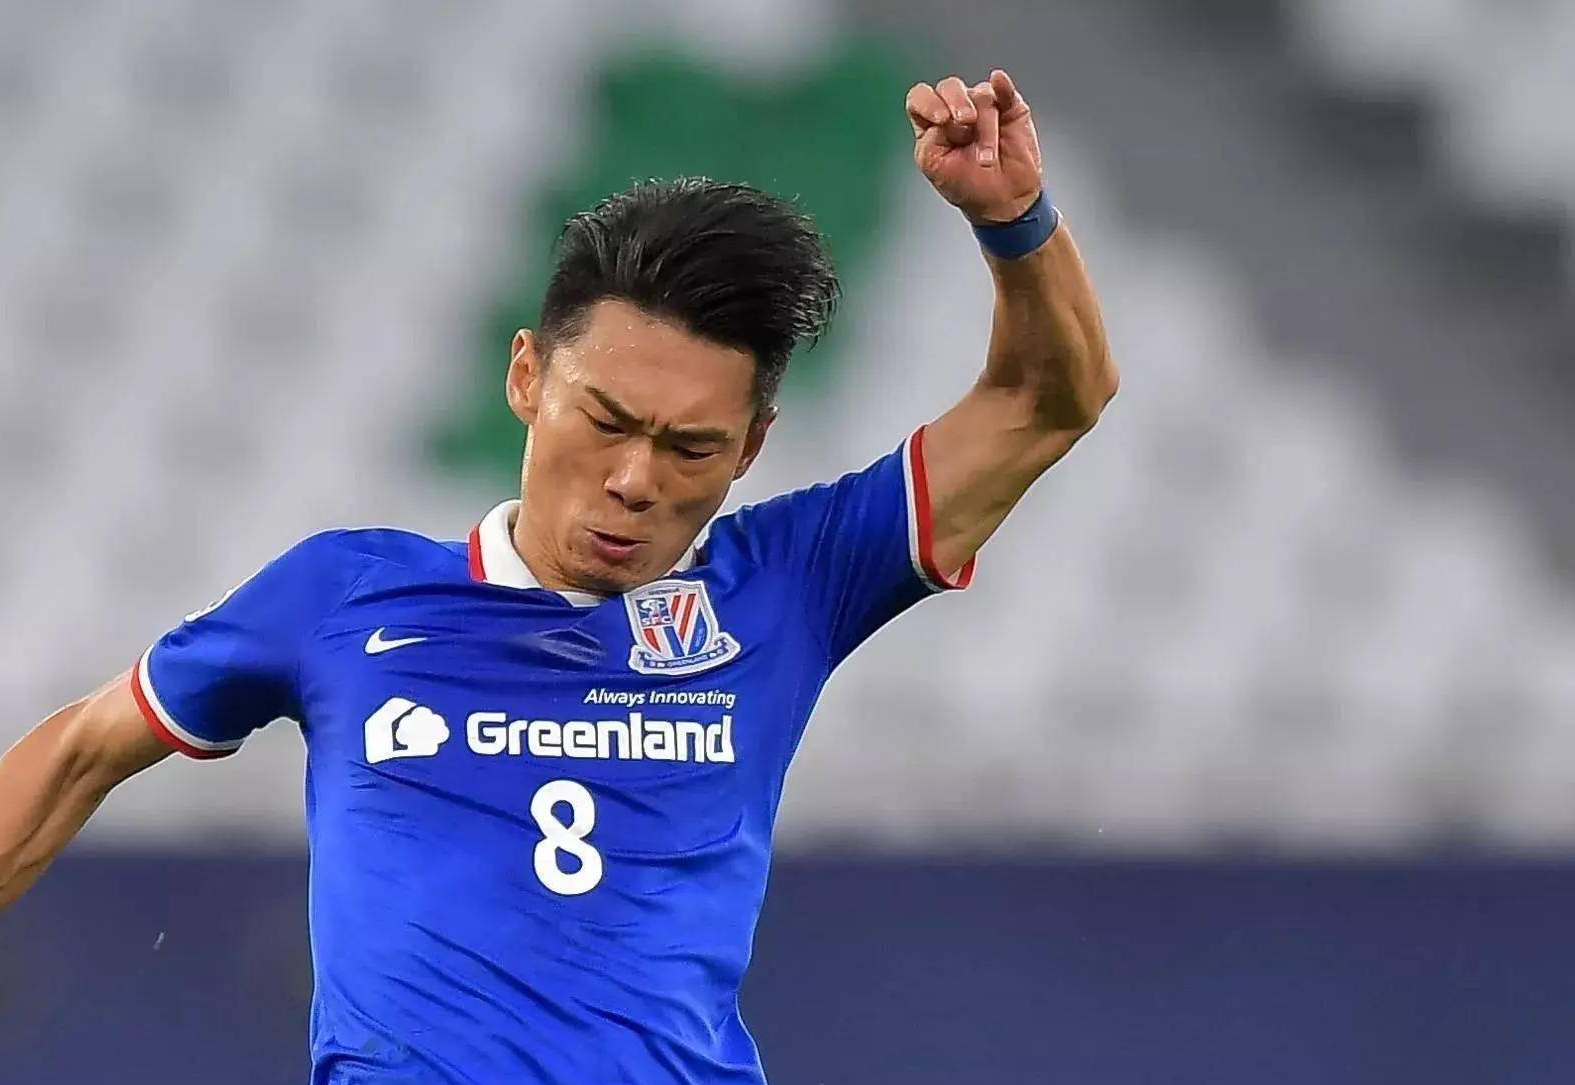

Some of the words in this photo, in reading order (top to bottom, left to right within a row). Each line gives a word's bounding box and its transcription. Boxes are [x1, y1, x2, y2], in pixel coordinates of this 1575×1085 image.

[584, 688, 645, 708] Always
[649, 689, 736, 709] Innovating
[466, 712, 736, 764] Greenland
[529, 779, 603, 896] 8
